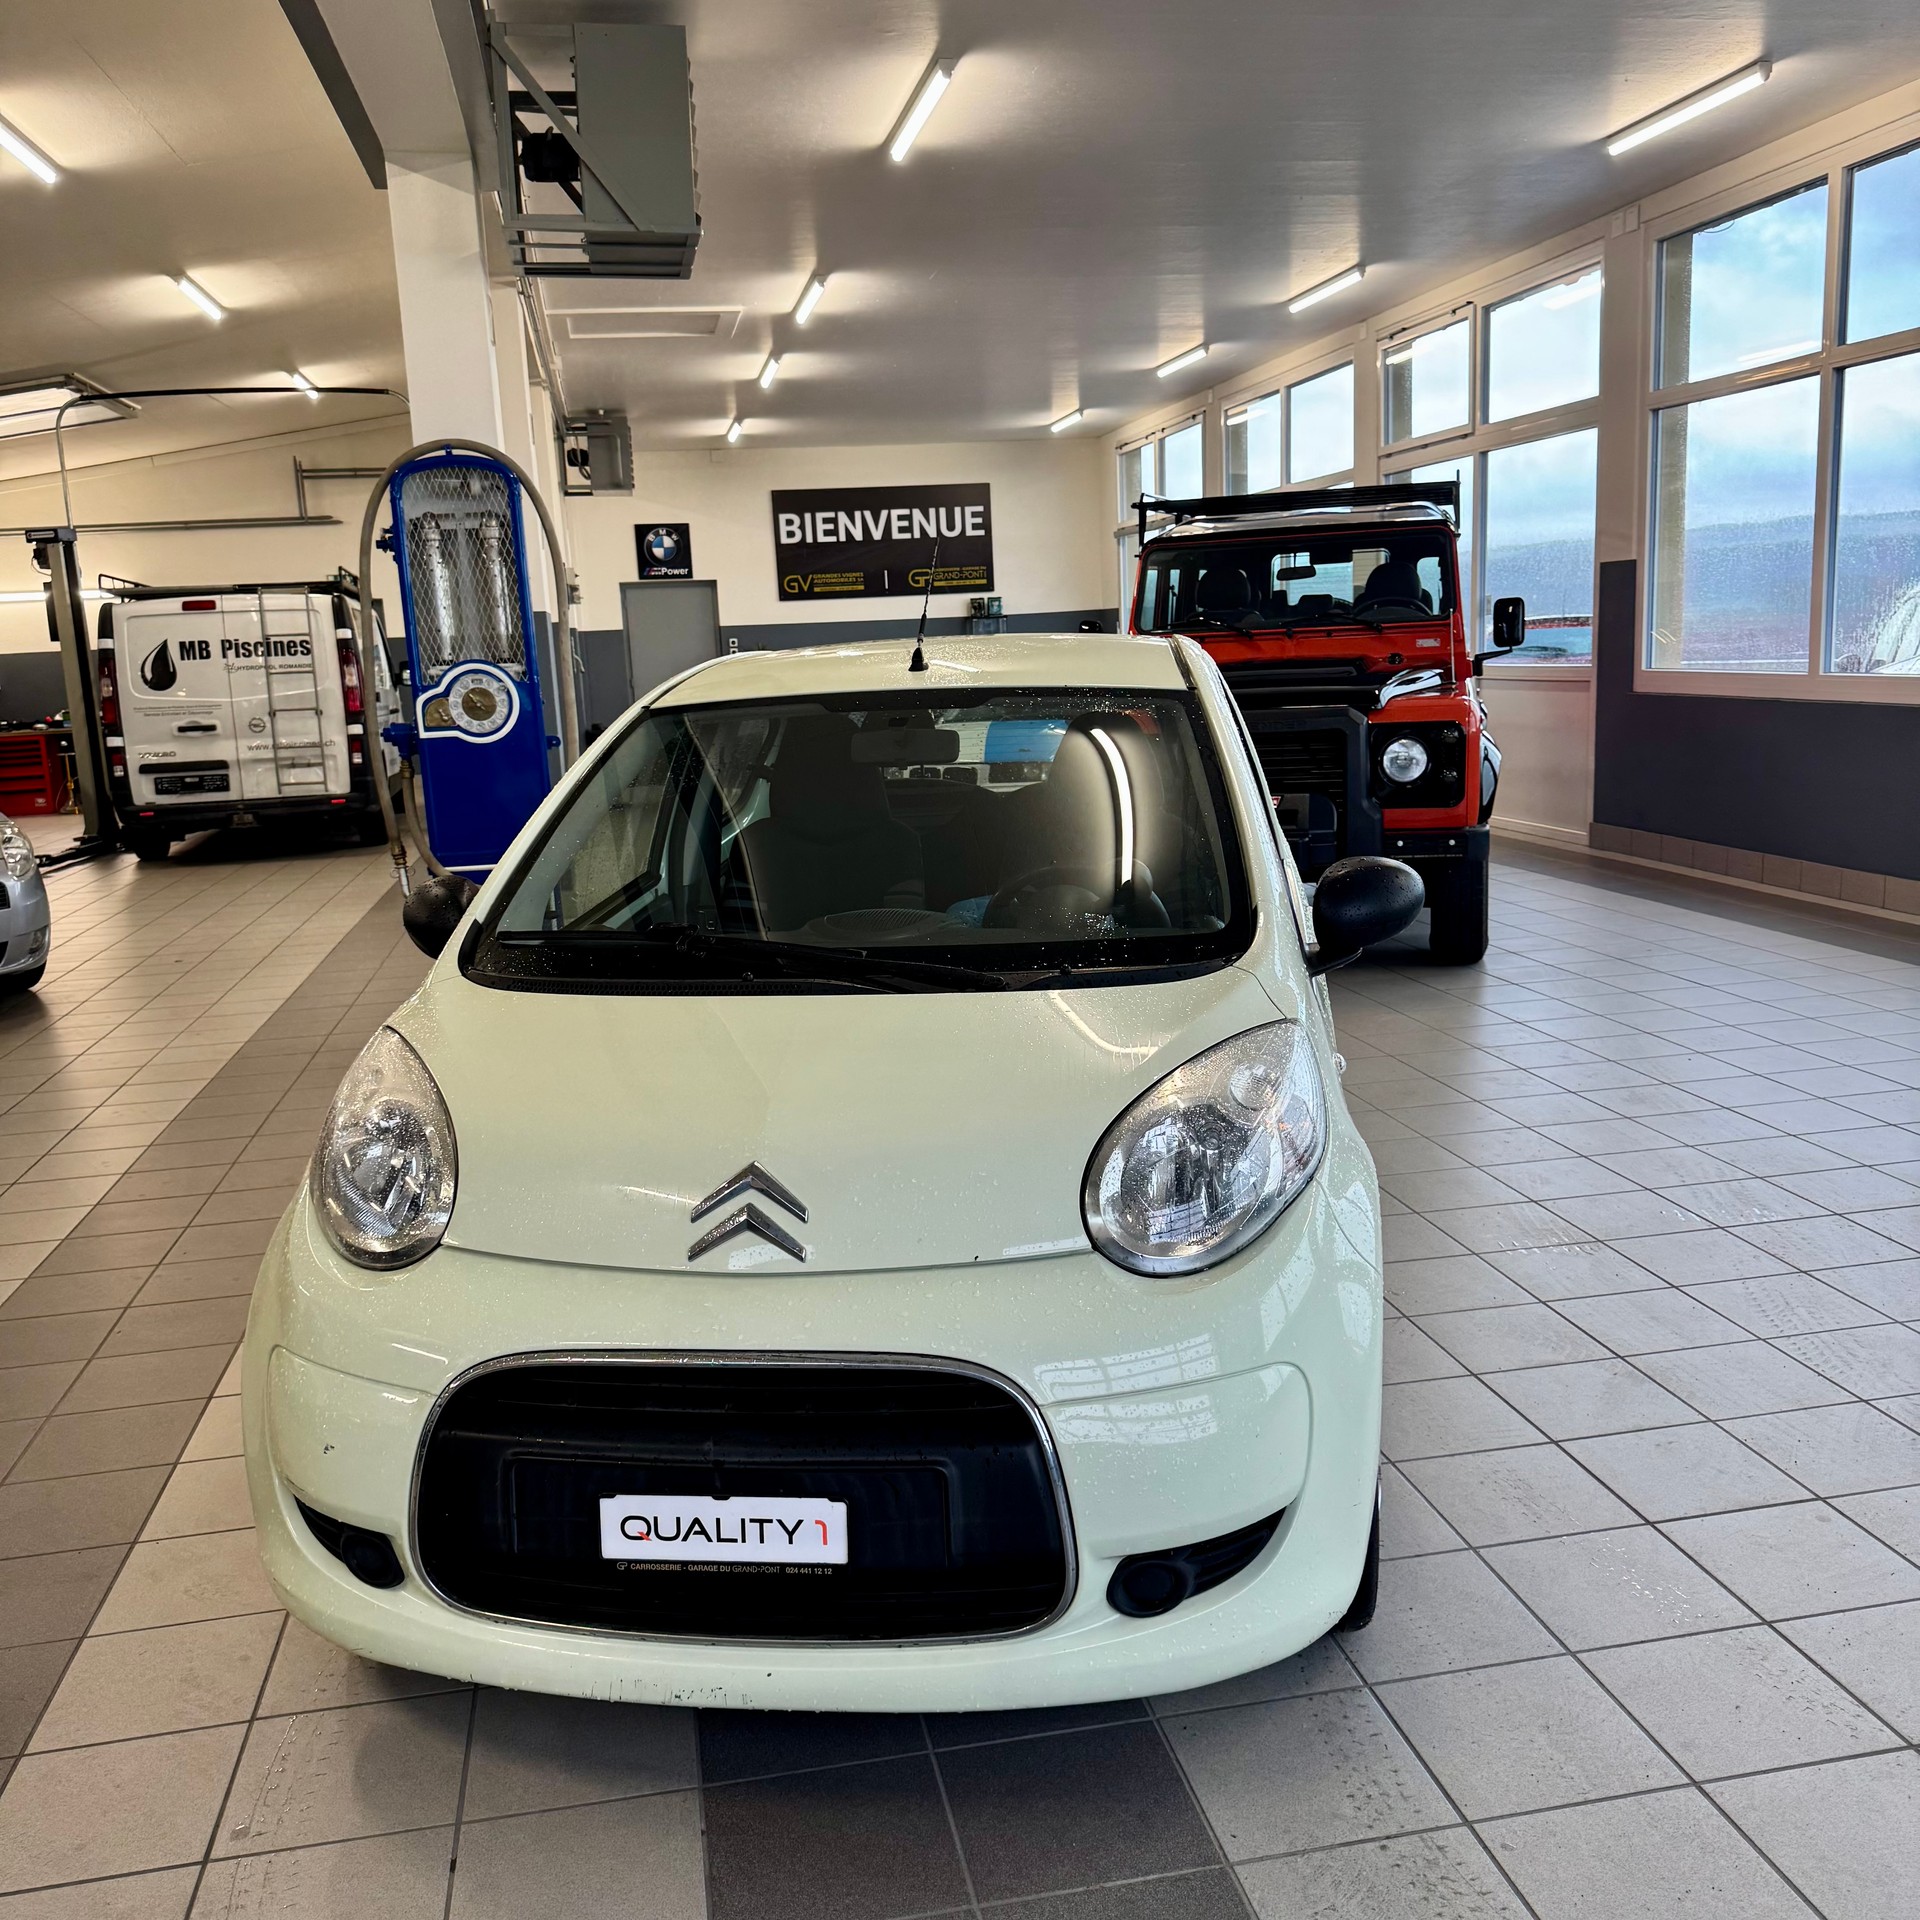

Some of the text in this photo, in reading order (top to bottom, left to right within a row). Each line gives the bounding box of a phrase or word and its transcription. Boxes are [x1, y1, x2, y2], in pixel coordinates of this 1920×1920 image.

[648, 528, 679, 541] BMW
[778, 505, 985, 545] BIENVENUE
[661, 567, 689, 575] Power
[783, 574, 813, 593] GV
[179, 638, 312, 661] MB Piscines
[620, 1515, 828, 1546] QUALITY 1
[630, 1563, 682, 1571] CARROSSERIE
[732, 1565, 780, 1574] GRAND-PONT
[785, 1566, 798, 1574] 024
